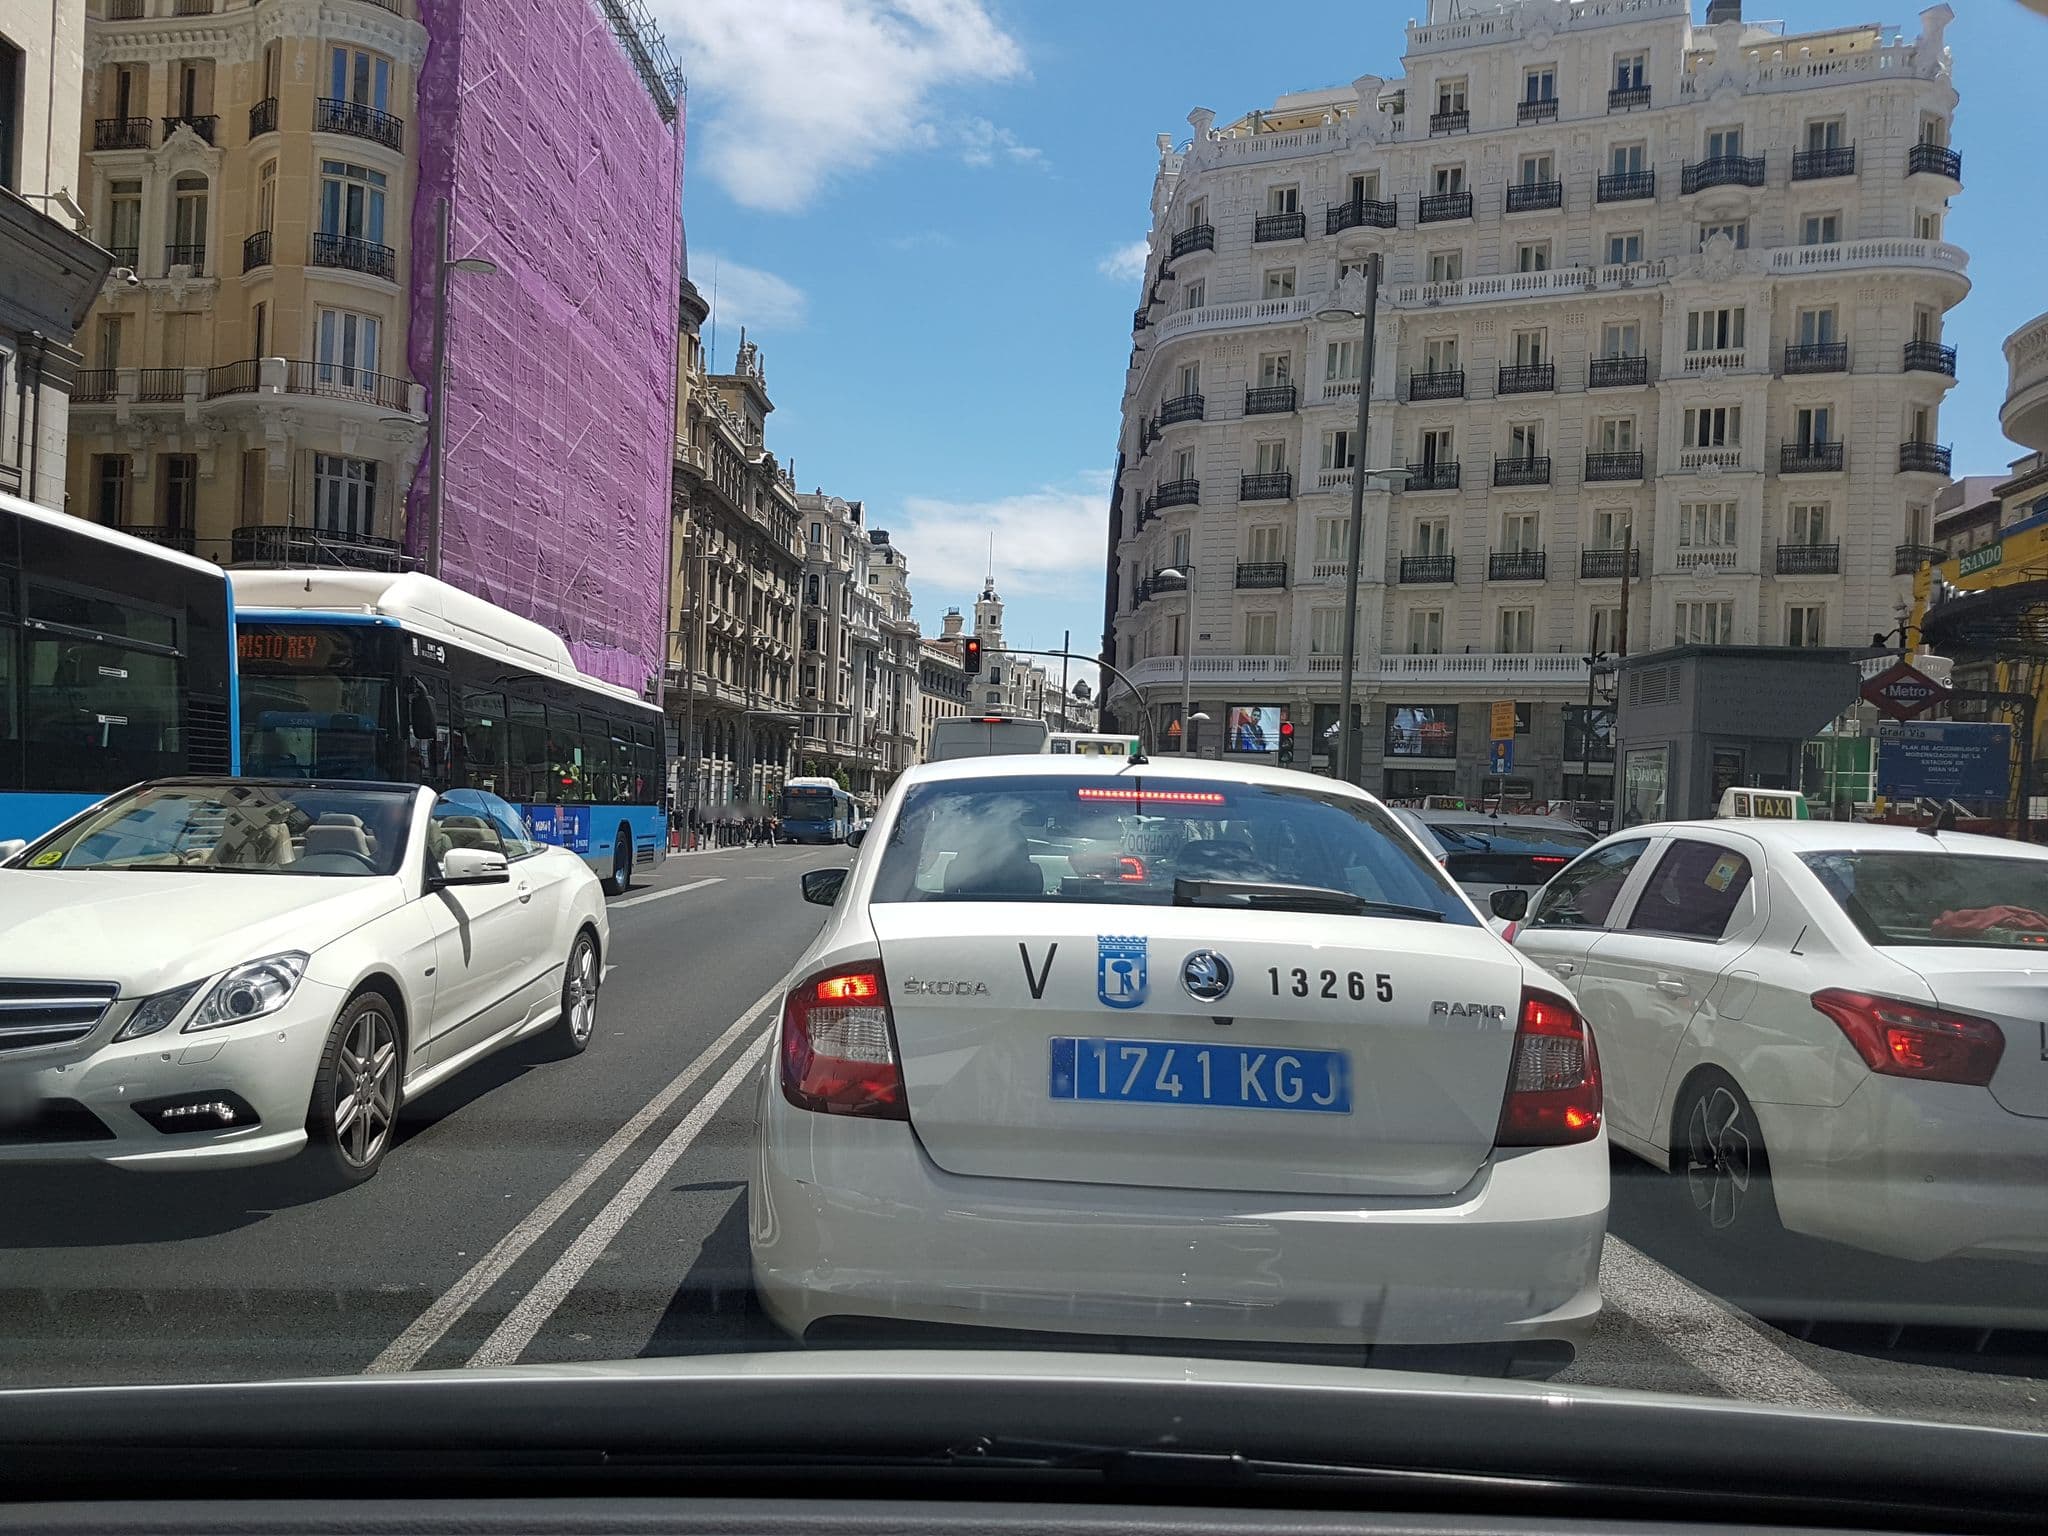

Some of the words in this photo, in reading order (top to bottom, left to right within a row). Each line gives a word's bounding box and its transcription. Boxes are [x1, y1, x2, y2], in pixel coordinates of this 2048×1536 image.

[1961, 545, 2001, 573] SANDO
[288, 636, 317, 659] REY
[1889, 685, 1927, 697] Metro
[1879, 727, 1905, 737] Gran
[1755, 797, 1791, 817] TAXI
[1018, 942, 1058, 1000] V
[1267, 966, 1394, 1003] 13265
[1432, 1000, 1506, 1020] RAPID
[1093, 1046, 1211, 1099] 1741
[1240, 1052, 1336, 1105] KGJ
